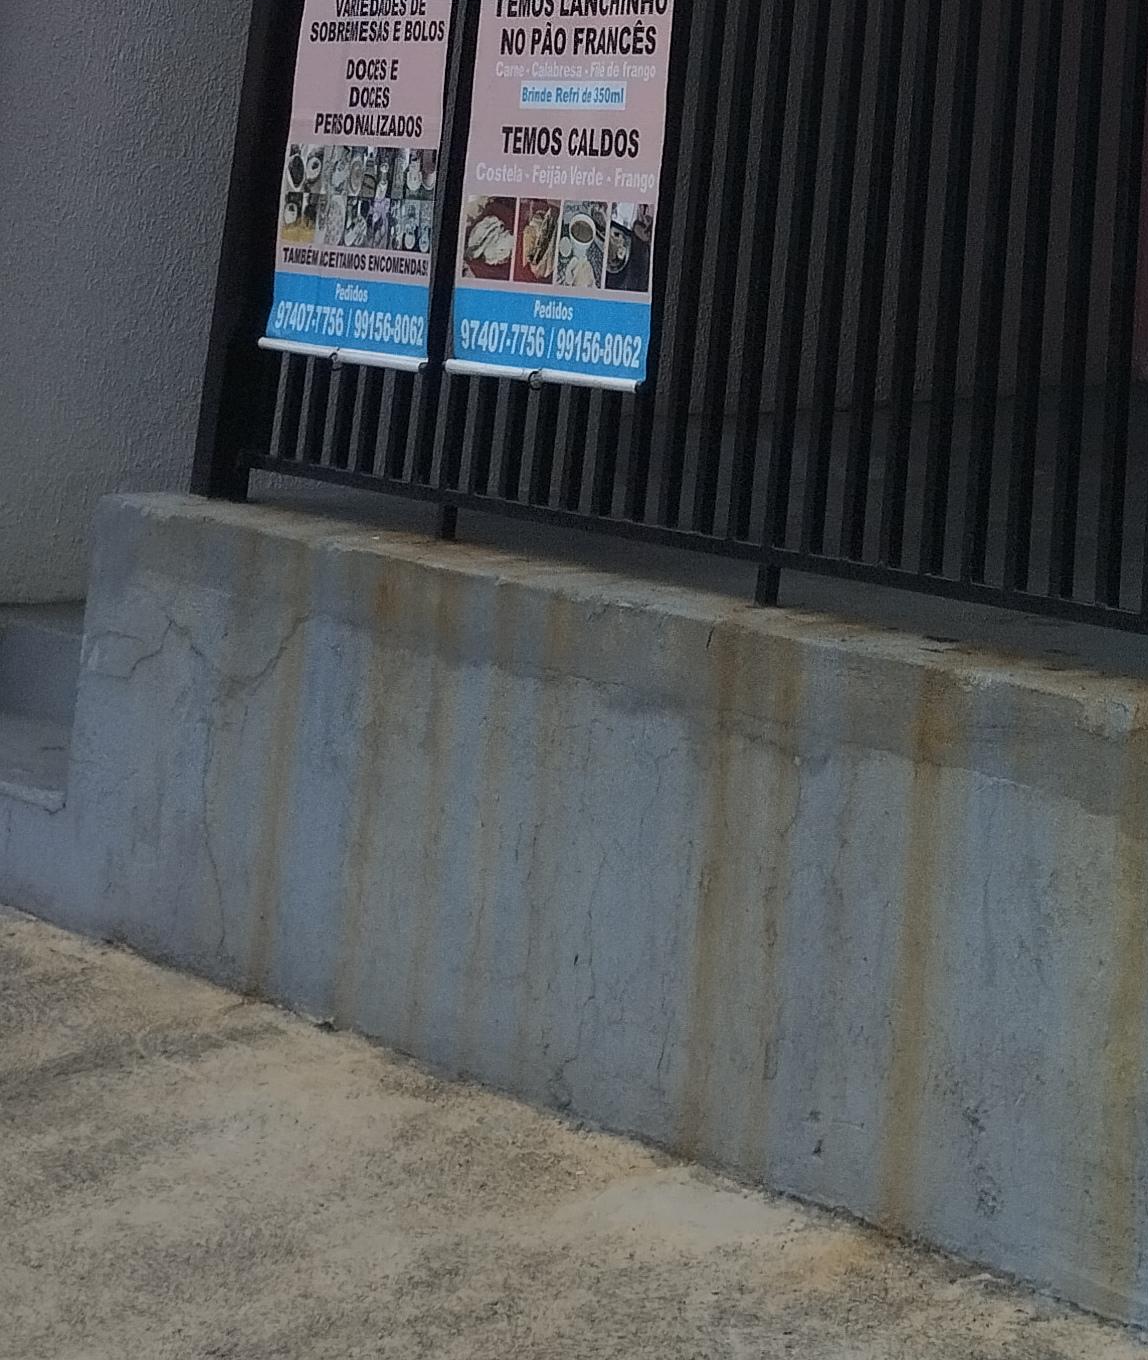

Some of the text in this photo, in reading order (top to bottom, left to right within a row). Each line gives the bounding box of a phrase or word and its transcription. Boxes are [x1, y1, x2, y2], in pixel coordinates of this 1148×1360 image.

[310, 21, 445, 42] SOBREMESAS E BOLOS
[500, 28, 526, 55] NO
[573, 20, 657, 55] FRANCÊS
[346, 59, 399, 80] DOCES E
[495, 61, 524, 78] Carne
[531, 62, 582, 78] Calabresa
[607, 63, 619, 78] de
[622, 62, 656, 82] frango
[349, 87, 390, 108] DOCES
[522, 87, 624, 104] Brinde Refri de 350ml
[314, 113, 423, 137] PERSONALIZADOS
[502, 126, 640, 158] TEMOS CALDOS
[476, 162, 523, 183] Costela
[532, 165, 568, 189] Feijão
[570, 166, 603, 186] Verde
[615, 167, 655, 193] Frango
[283, 246, 319, 266] TAMBÉM
[335, 284, 368, 302] Pedidos
[533, 299, 574, 321] Pedidos
[354, 310, 424, 346] 99156-8062
[460, 319, 545, 358] 97407-7756
[556, 328, 642, 369] 99156-8062
